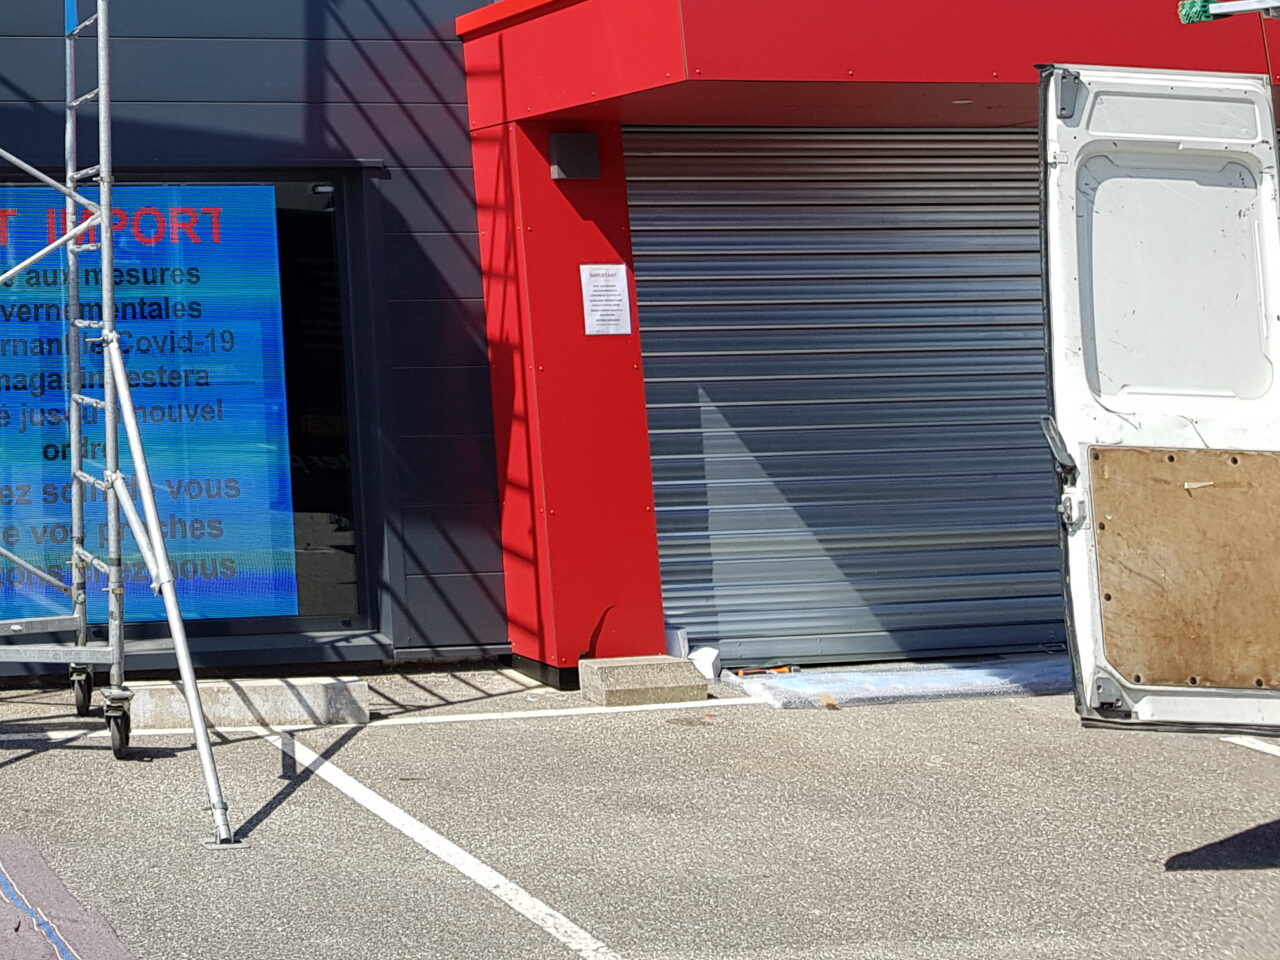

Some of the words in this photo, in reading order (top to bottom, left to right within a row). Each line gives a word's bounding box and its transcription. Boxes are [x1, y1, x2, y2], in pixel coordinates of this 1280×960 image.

[84, 265, 202, 287] mesures
[120, 364, 210, 388] estera
[132, 397, 225, 424] nouvel
[165, 477, 242, 500] vous
